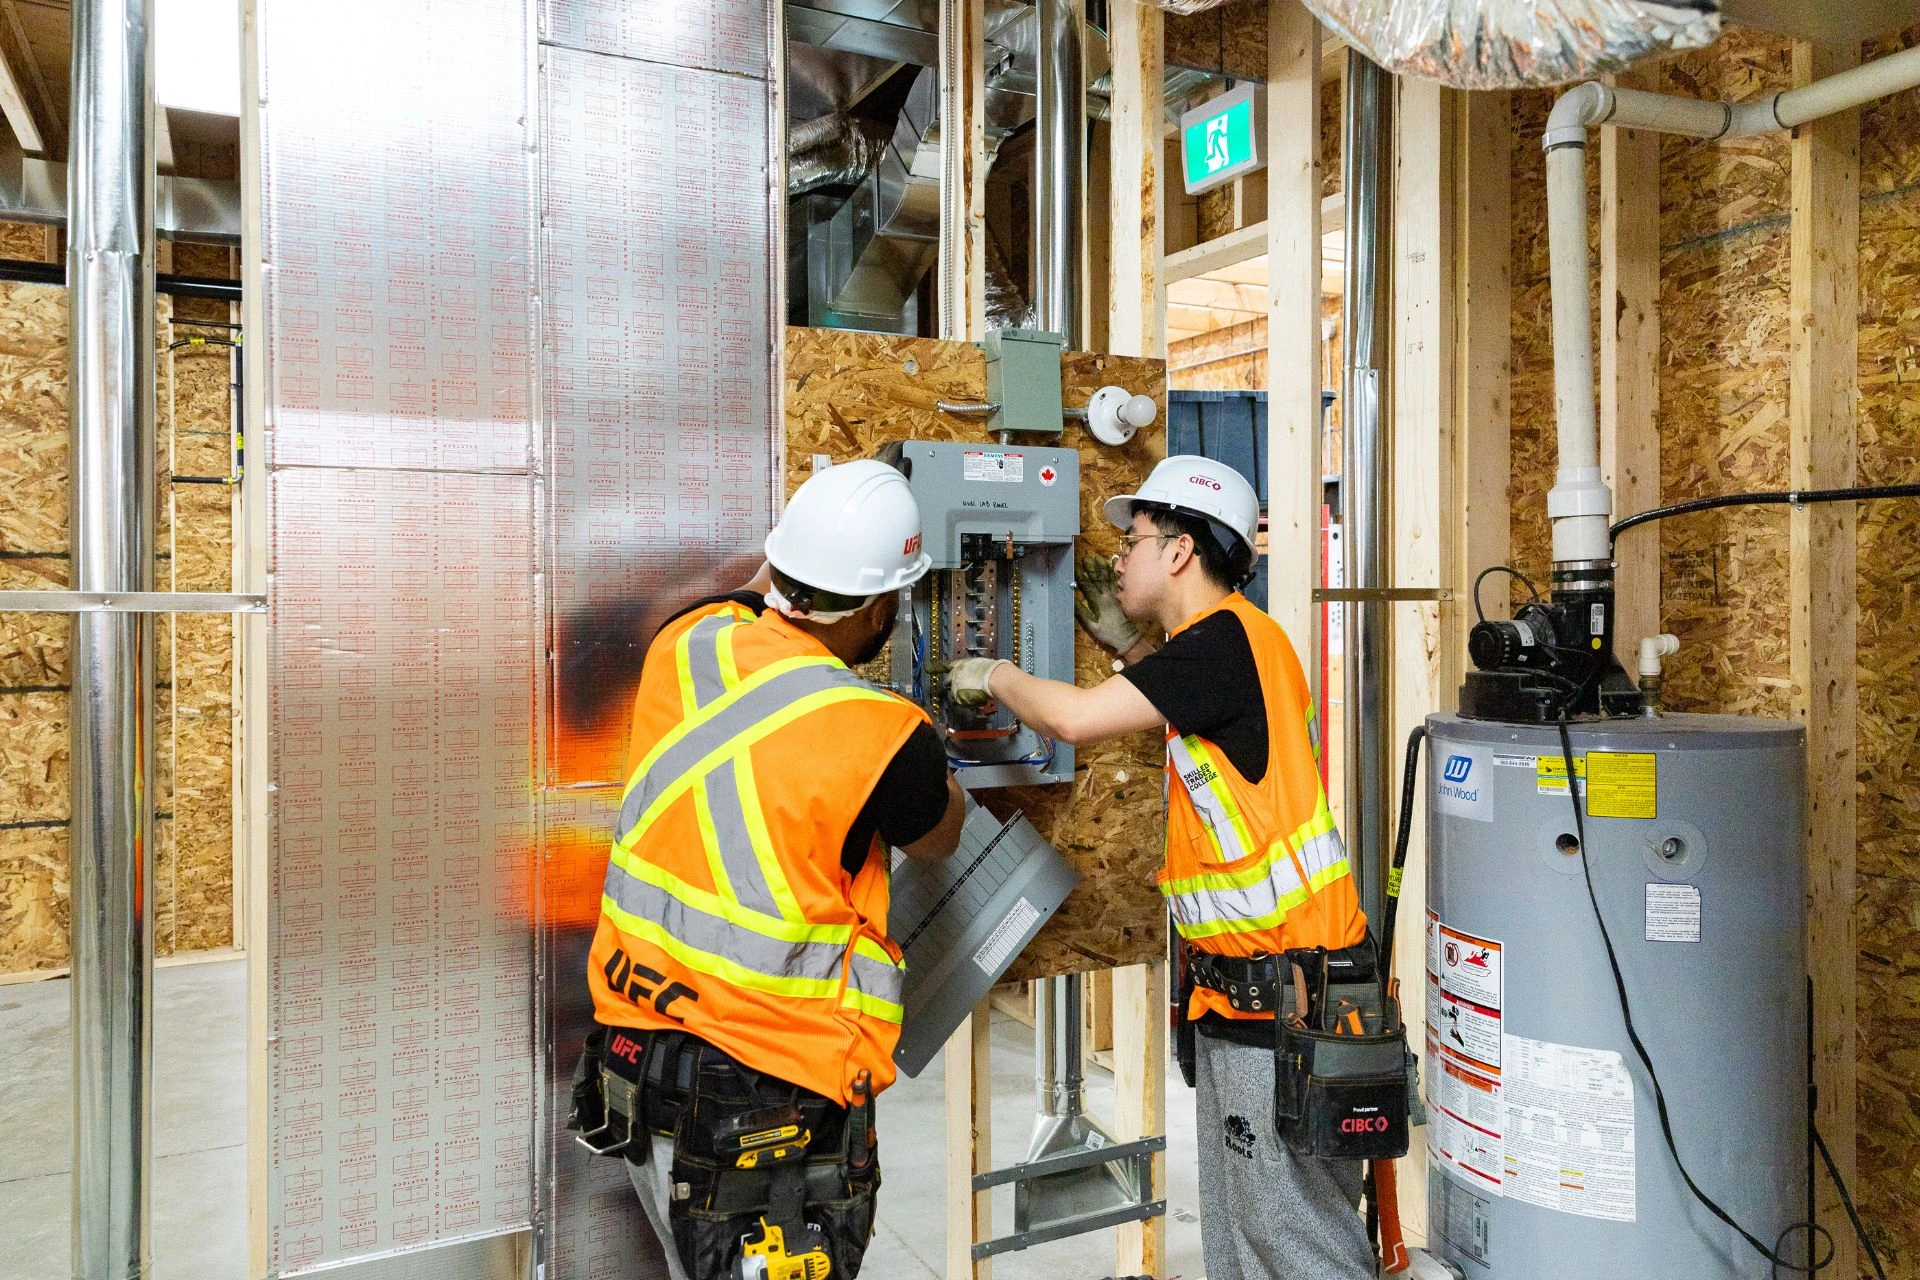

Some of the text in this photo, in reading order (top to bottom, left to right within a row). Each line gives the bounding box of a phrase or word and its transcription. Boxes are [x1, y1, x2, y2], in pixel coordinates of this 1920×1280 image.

[1189, 476, 1212, 488] CIBC
[1184, 763, 1210, 781] SKILLED
[1186, 769, 1212, 785] TRADES
[1190, 772, 1218, 791] COLLEGE
[1438, 782, 1476, 801] John Wood
[604, 947, 699, 1024] UFC
[611, 1033, 643, 1064] UFC
[1341, 1118, 1374, 1132] CIBC
[1225, 1135, 1253, 1159] Roots
